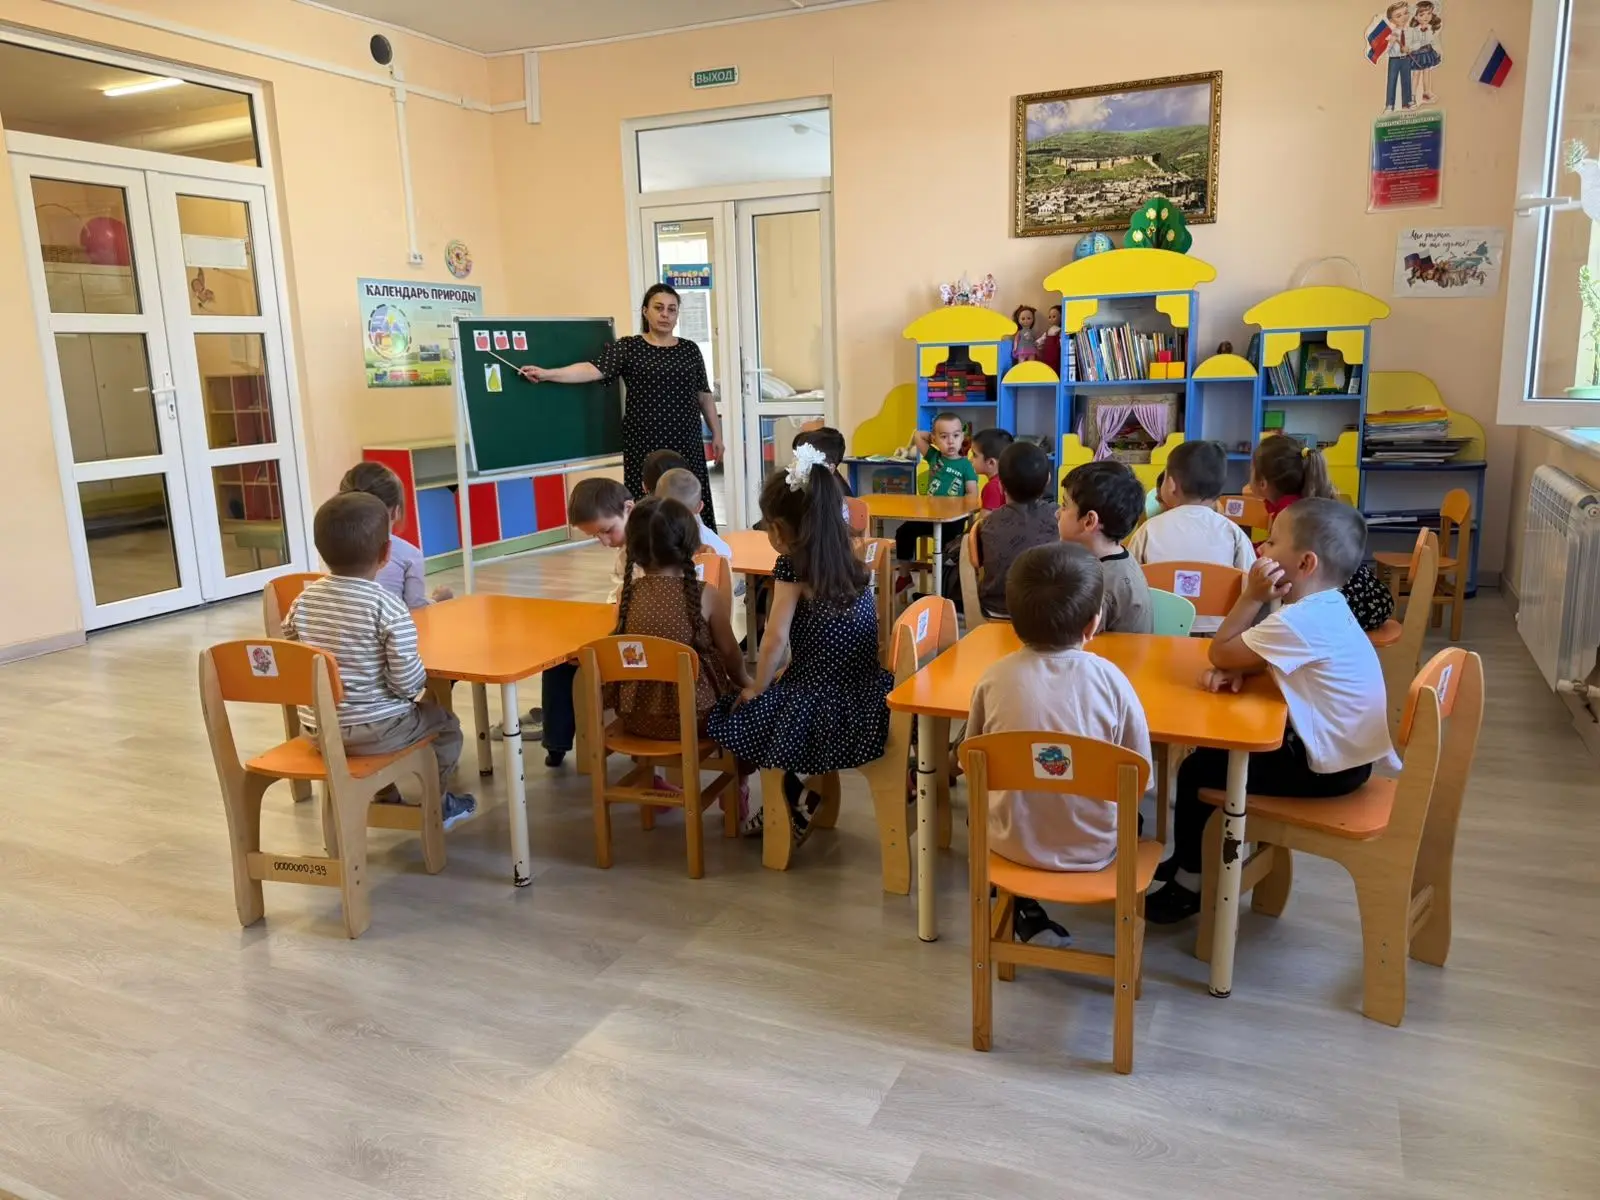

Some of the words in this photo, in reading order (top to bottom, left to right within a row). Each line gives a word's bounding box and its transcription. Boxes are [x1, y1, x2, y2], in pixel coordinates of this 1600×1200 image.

[696, 70, 733, 84] ВЫХОД
[674, 277, 702, 287] СПАЛЬНЯ
[366, 284, 430, 301] КАЛЕНДАРЬ
[431, 288, 477, 304] ПРИРОДЫ
